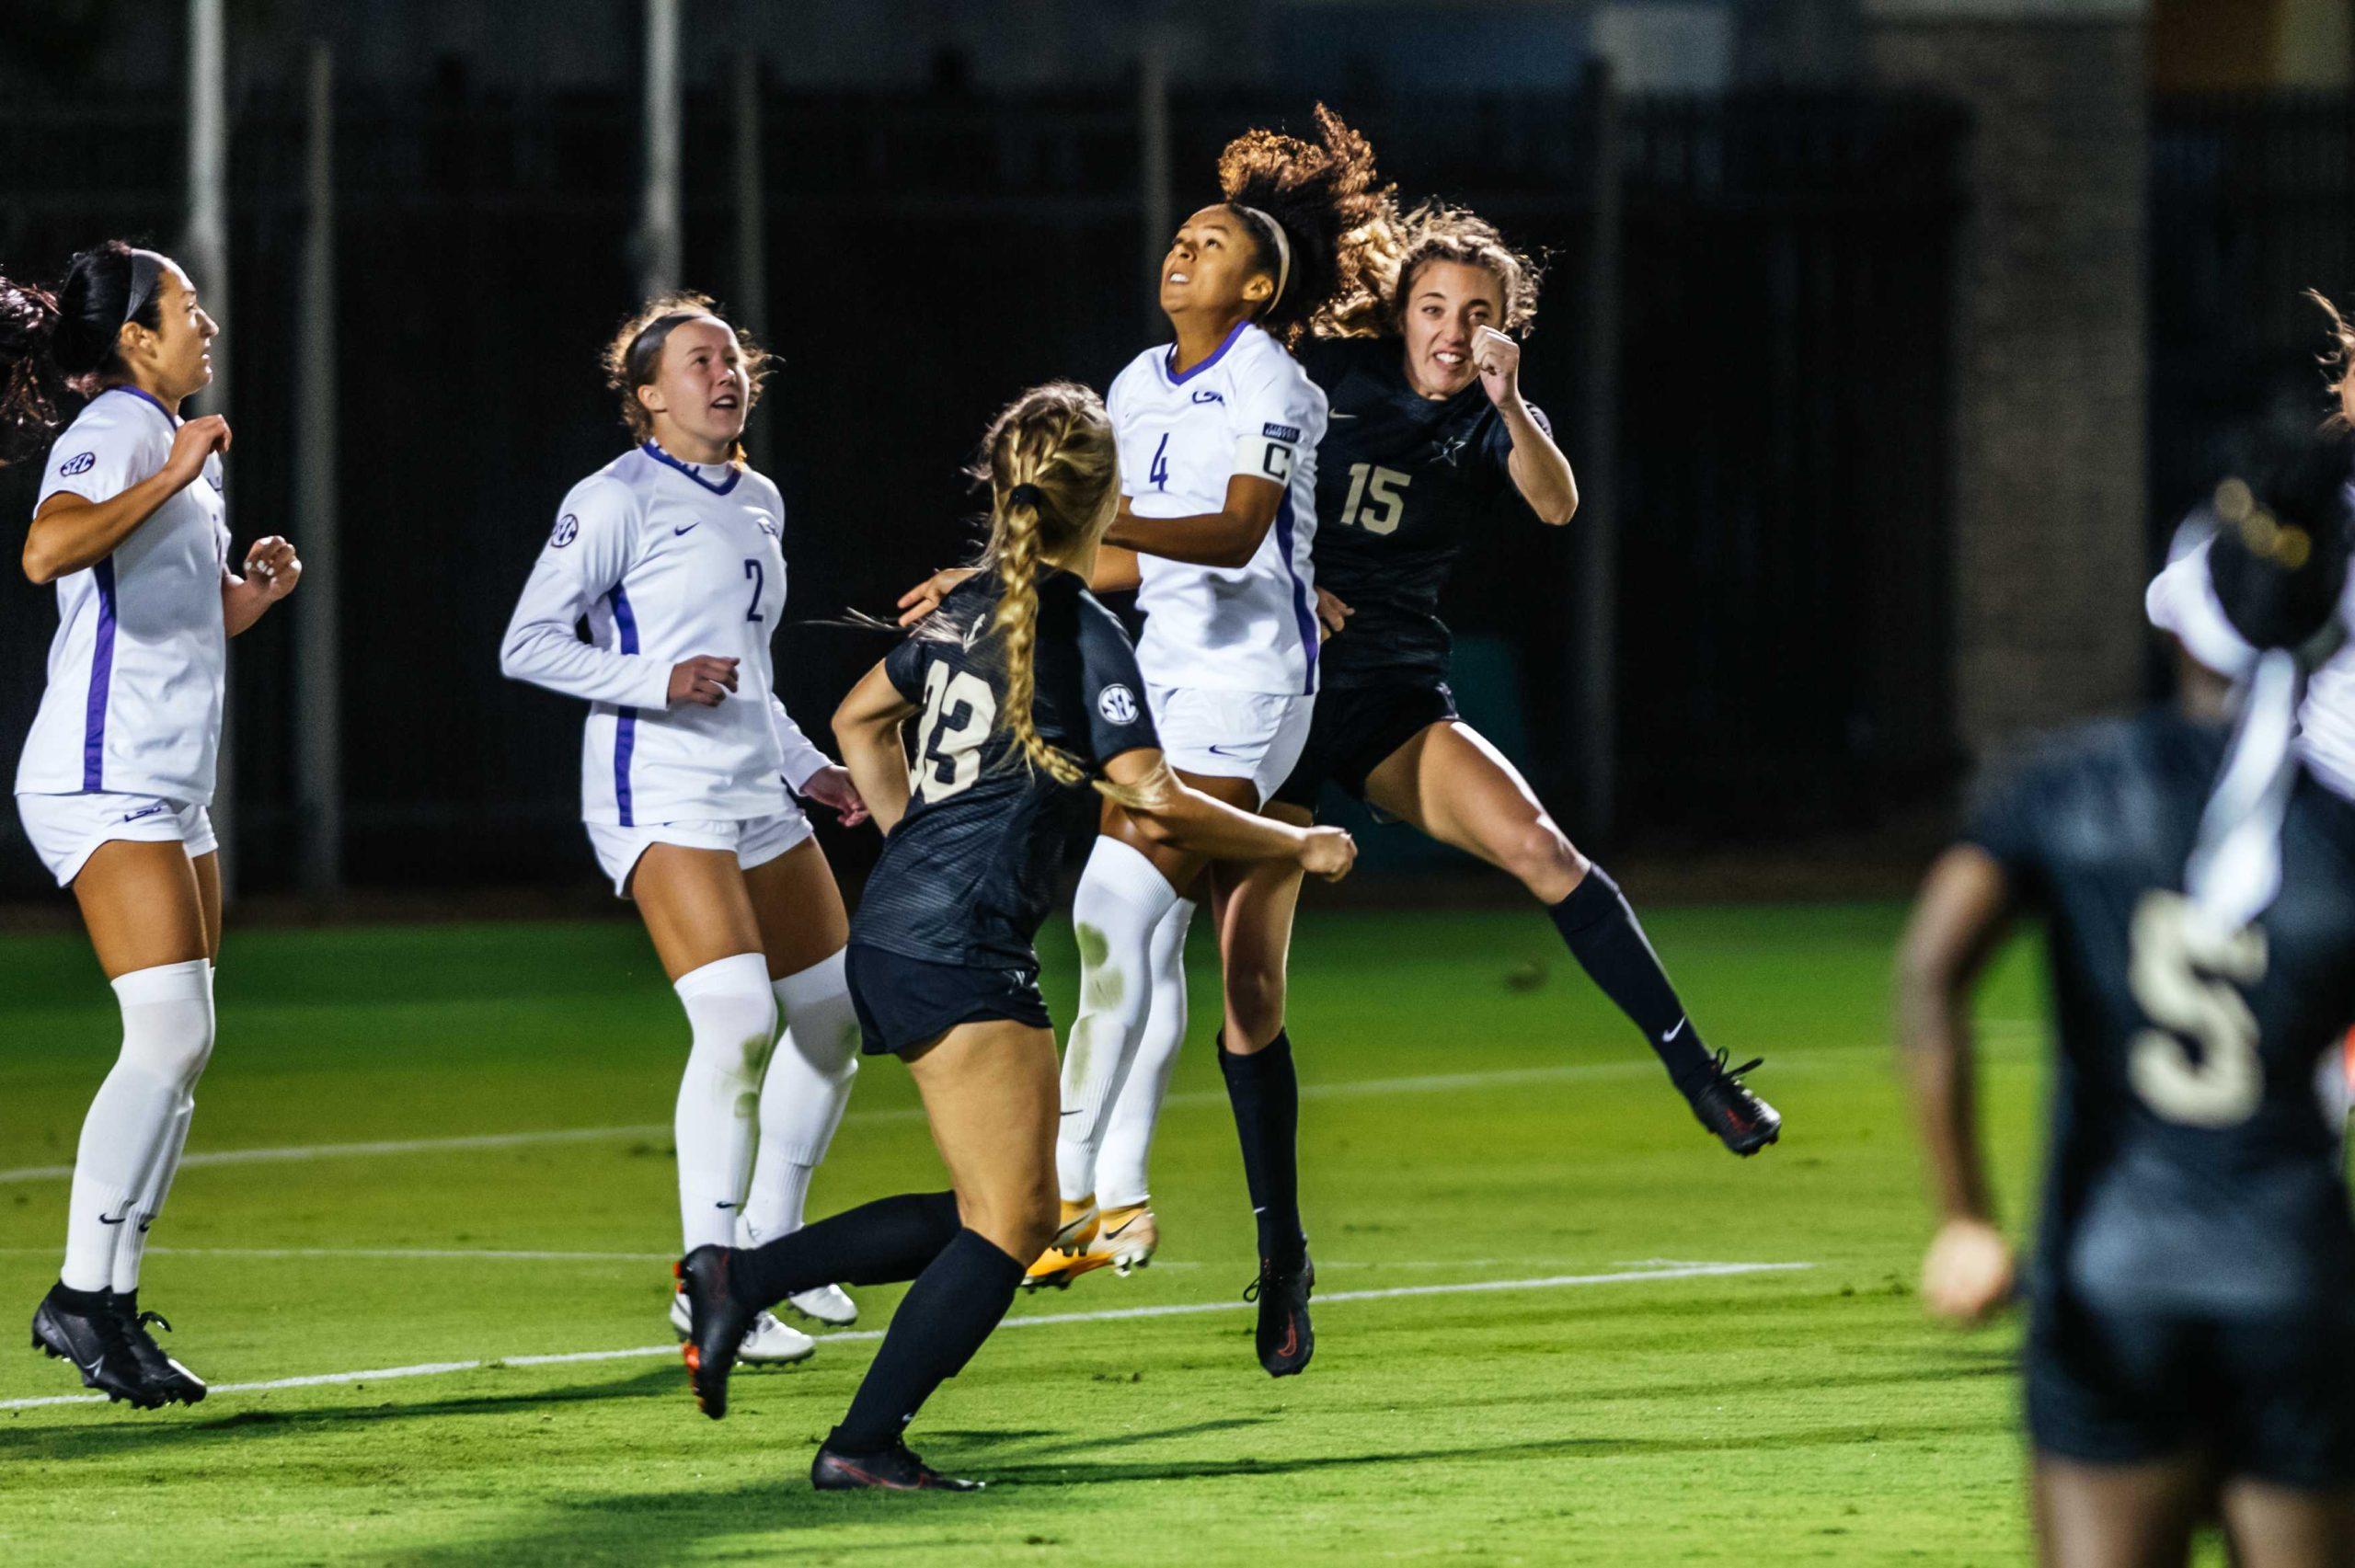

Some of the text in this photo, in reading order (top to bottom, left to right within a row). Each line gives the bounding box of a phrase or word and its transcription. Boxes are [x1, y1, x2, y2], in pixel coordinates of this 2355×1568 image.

[61, 452, 95, 476] SEC
[1150, 432, 1169, 492] 4
[1263, 442, 1292, 480] C
[1339, 463, 1412, 535] 15
[744, 558, 764, 622] 2
[1100, 685, 1137, 724] SEC
[2126, 889, 2269, 1129] 5
